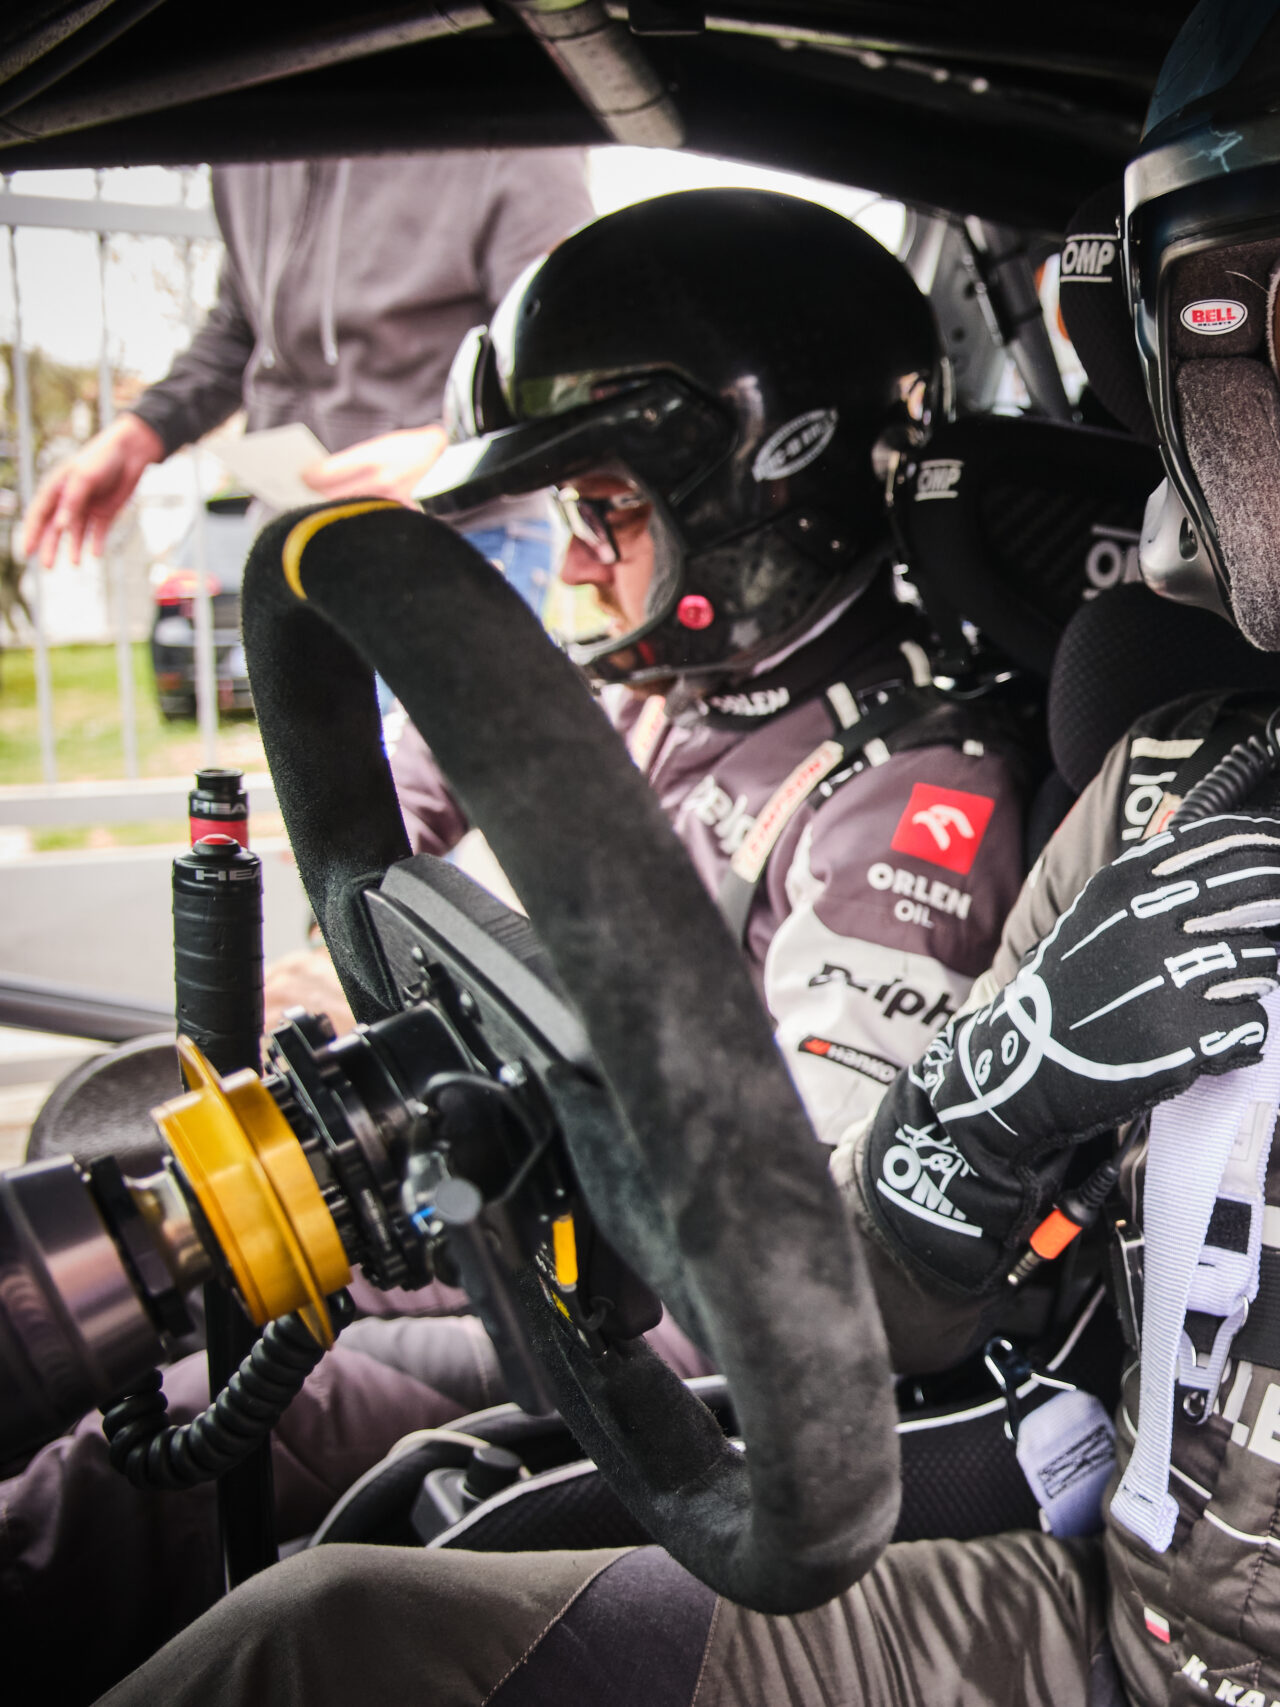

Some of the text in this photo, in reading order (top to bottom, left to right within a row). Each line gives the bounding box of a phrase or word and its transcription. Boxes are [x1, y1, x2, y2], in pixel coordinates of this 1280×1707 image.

[1061, 240, 1116, 275] OMP
[1192, 307, 1237, 323] BELL
[917, 466, 962, 492] OMP
[192, 799, 247, 815] HEA
[867, 862, 972, 920] ORLEN
[894, 899, 935, 929] OIL
[826, 1043, 898, 1083] Hanko
[883, 1145, 967, 1222] OM
[1181, 1654, 1209, 1688] K.
